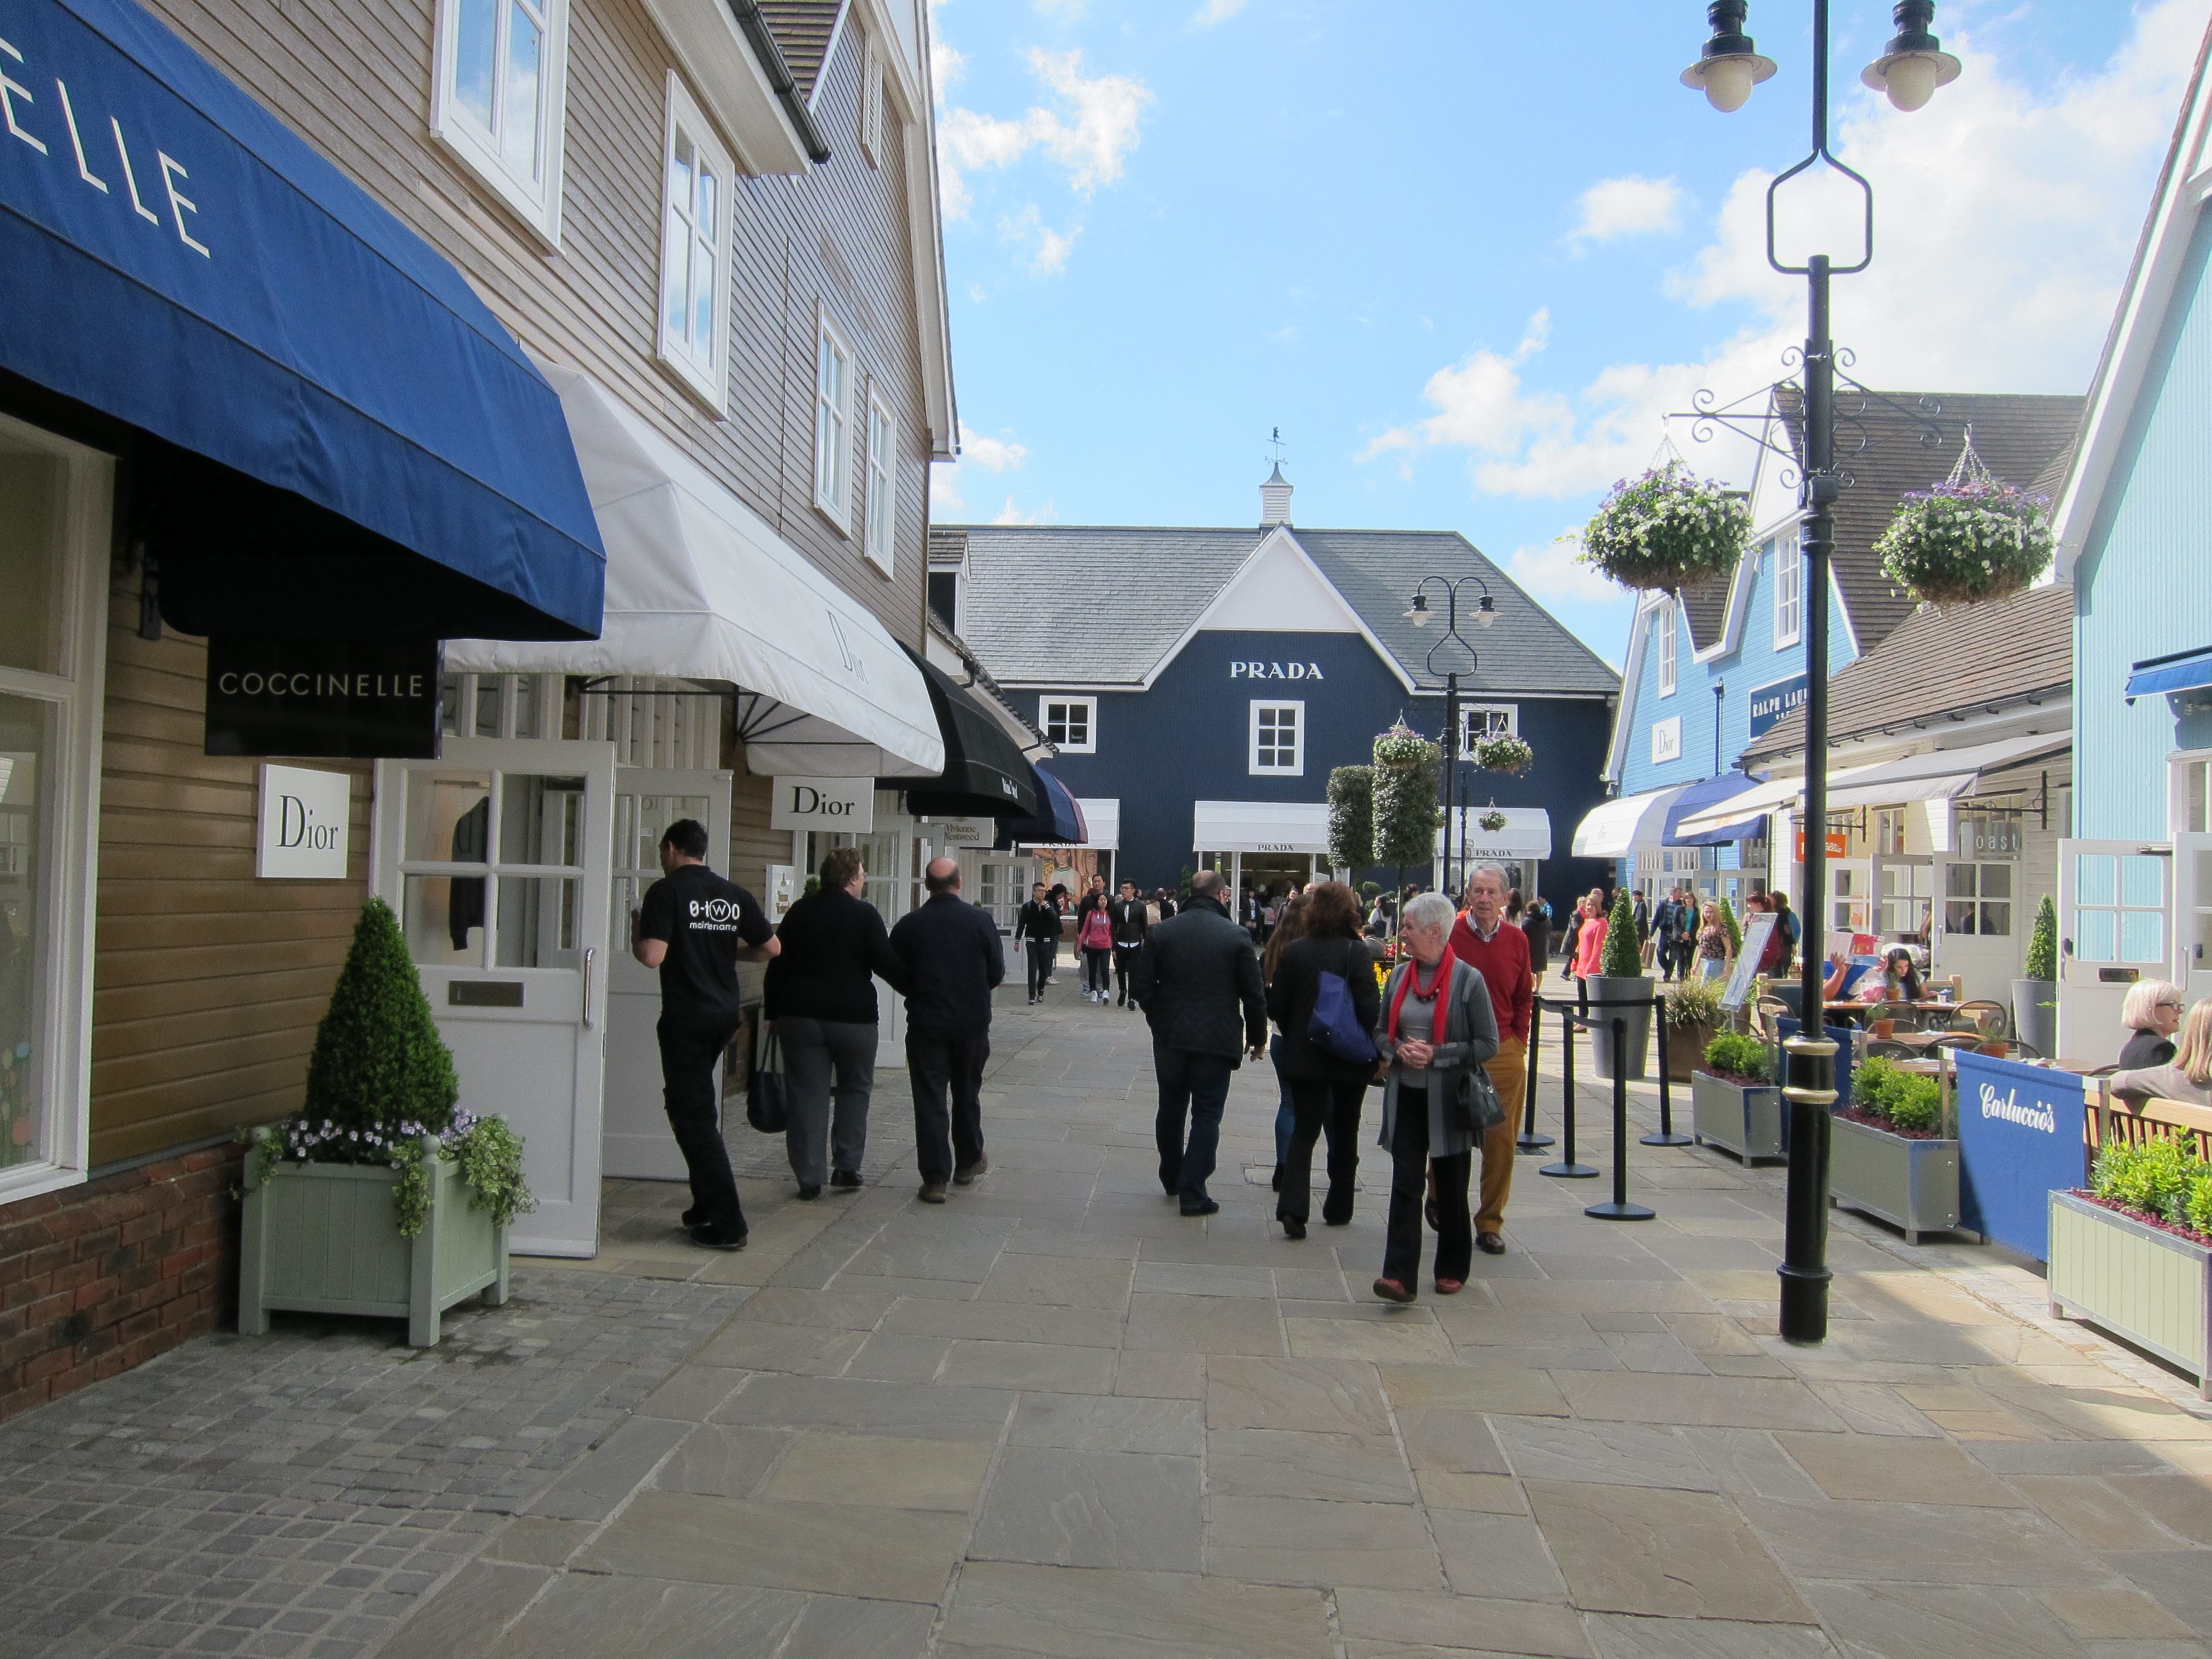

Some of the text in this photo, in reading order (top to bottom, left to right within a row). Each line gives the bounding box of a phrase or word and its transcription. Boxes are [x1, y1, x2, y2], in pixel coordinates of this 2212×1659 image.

[825, 608, 869, 685] Dior
[1230, 661, 1324, 680] PRADA
[219, 672, 423, 697] COCCINELLE
[1752, 696, 1780, 718] RALPH
[1658, 729, 1674, 754] Dior
[789, 786, 855, 816] Dior
[275, 794, 339, 850] Dior
[945, 823, 977, 833] Vivienne
[1979, 1083, 2055, 1133] Carluccio's
